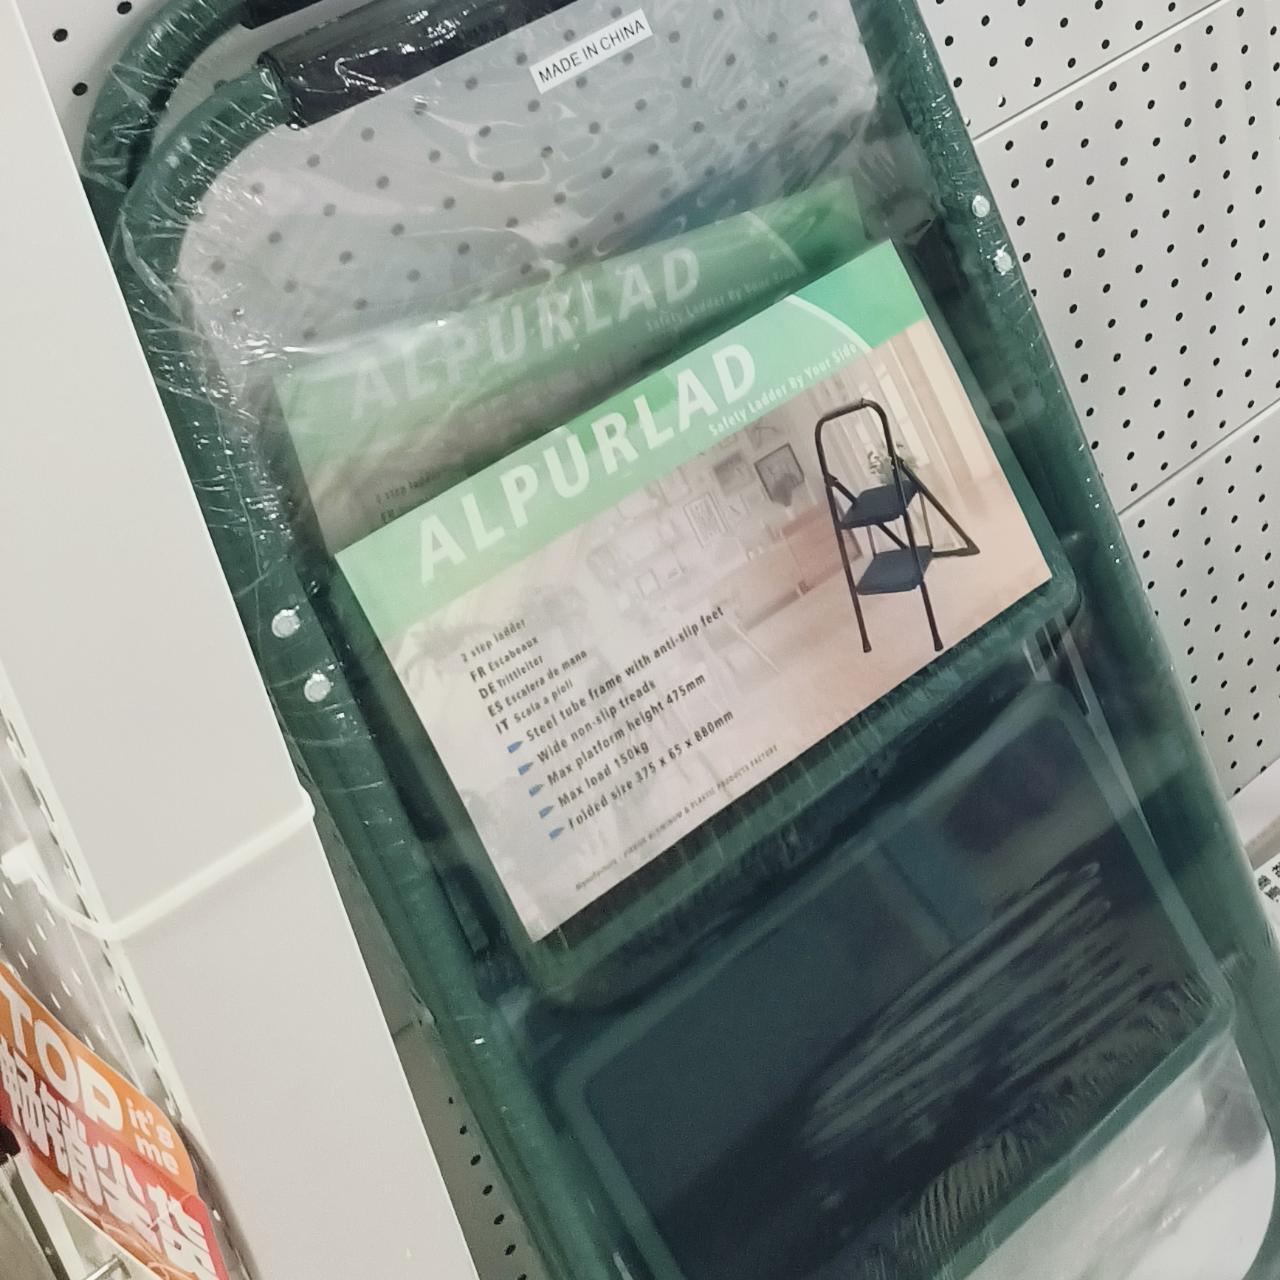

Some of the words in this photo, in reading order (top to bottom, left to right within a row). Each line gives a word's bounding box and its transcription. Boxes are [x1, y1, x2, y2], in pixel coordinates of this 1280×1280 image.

[538, 52, 582, 83] MADE
[582, 44, 599, 60] IN
[600, 20, 646, 51] CHINA
[351, 247, 700, 421] ALPURLAD
[708, 408, 749, 436] Safety
[748, 383, 787, 413] Ladder
[788, 374, 804, 389] By
[804, 359, 831, 379] Your
[831, 343, 857, 363] Side
[419, 343, 757, 585] ALPURLAD
[470, 636, 493, 658] step
[493, 618, 527, 642] ladder
[470, 665, 488, 682] FR
[488, 636, 539, 672] Escabeaux
[478, 681, 498, 700] DE
[496, 654, 544, 691] Trittleiter
[488, 700, 504, 717] ES
[505, 676, 546, 706] Escalera
[546, 666, 560, 680] de
[561, 650, 588, 671] mano
[495, 720, 510, 736] IT
[514, 698, 542, 723] Scala
[550, 679, 575, 702] pioli
[526, 714, 559, 742] Steel
[560, 697, 587, 720] tube
[588, 674, 623, 701] frame
[625, 654, 652, 678] with
[653, 623, 700, 658] anti-slip
[700, 606, 724, 628] feet
[536, 738, 569, 764] Wide
[570, 705, 618, 742] non-slip
[618, 679, 657, 710] treads
[546, 762, 572, 786] Max
[576, 726, 626, 771] platform
[626, 700, 664, 732] height
[666, 672, 706, 706] 475mm
[558, 784, 584, 808] Max
[585, 767, 612, 790] load
[614, 740, 650, 769] 150kg
[568, 796, 608, 830] Folded
[610, 780, 634, 801] size
[667, 743, 684, 761] 65
[693, 709, 734, 742] 880mm
[0, 973, 123, 1131] TOP
[126, 1097, 175, 1150] it's
[135, 1134, 180, 1176] me
